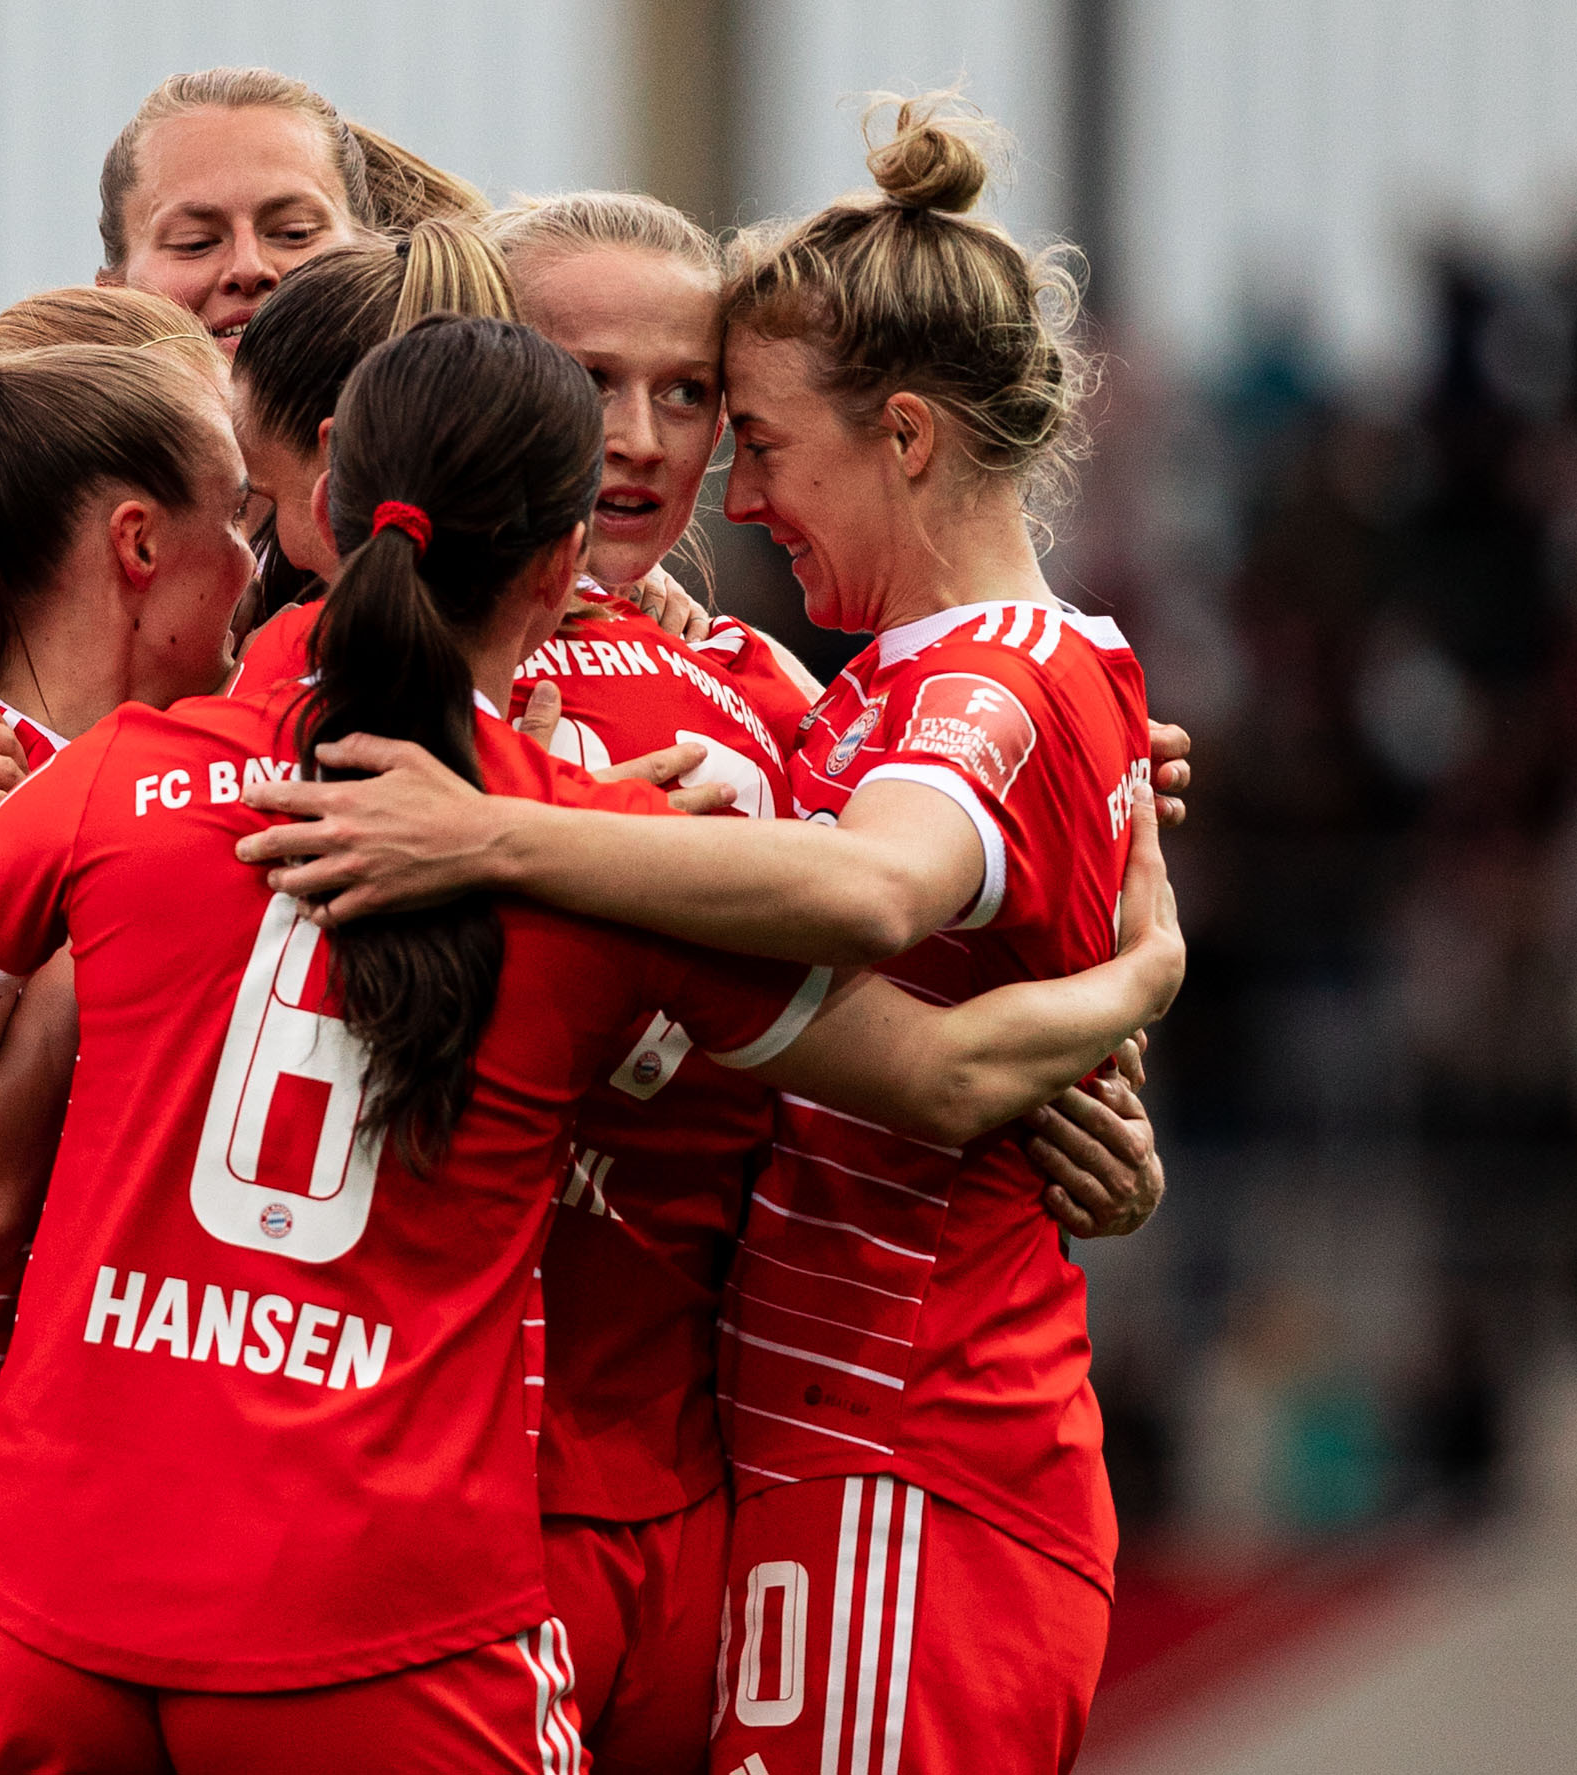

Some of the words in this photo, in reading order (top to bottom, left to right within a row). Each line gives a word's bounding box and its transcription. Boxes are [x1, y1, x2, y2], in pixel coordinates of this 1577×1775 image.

[135, 769, 192, 817] FC
[209, 756, 301, 804] BAY
[189, 891, 389, 1264] 6
[83, 1265, 393, 1390] HANSEN
